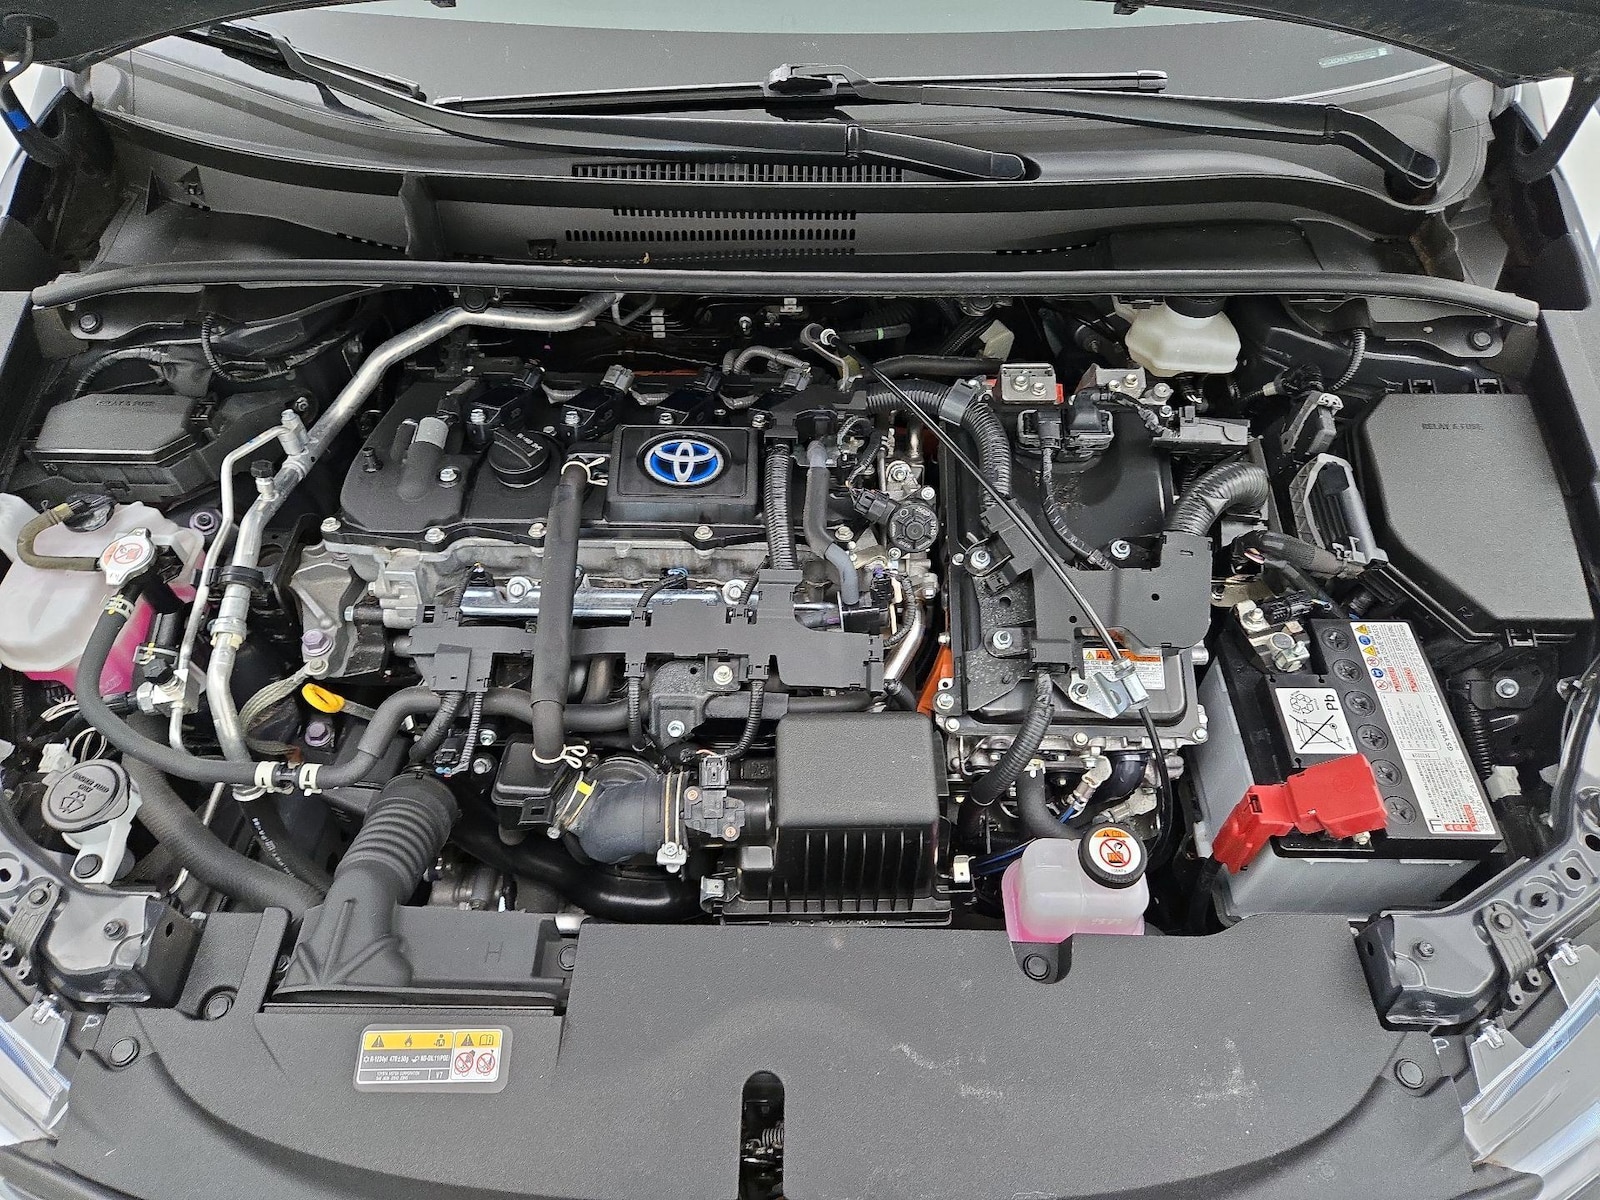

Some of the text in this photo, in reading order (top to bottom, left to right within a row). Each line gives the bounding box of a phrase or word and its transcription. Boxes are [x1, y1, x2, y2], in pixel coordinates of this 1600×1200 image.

[1421, 422, 1449, 430] RELAY
[1460, 422, 1484, 431] FUSE
[1369, 624, 1382, 640] GASES
[1325, 694, 1339, 711] Pb
[1434, 718, 1450, 741] YUASA
[1444, 742, 1454, 751] GS
[1432, 1037, 1450, 1055] P
